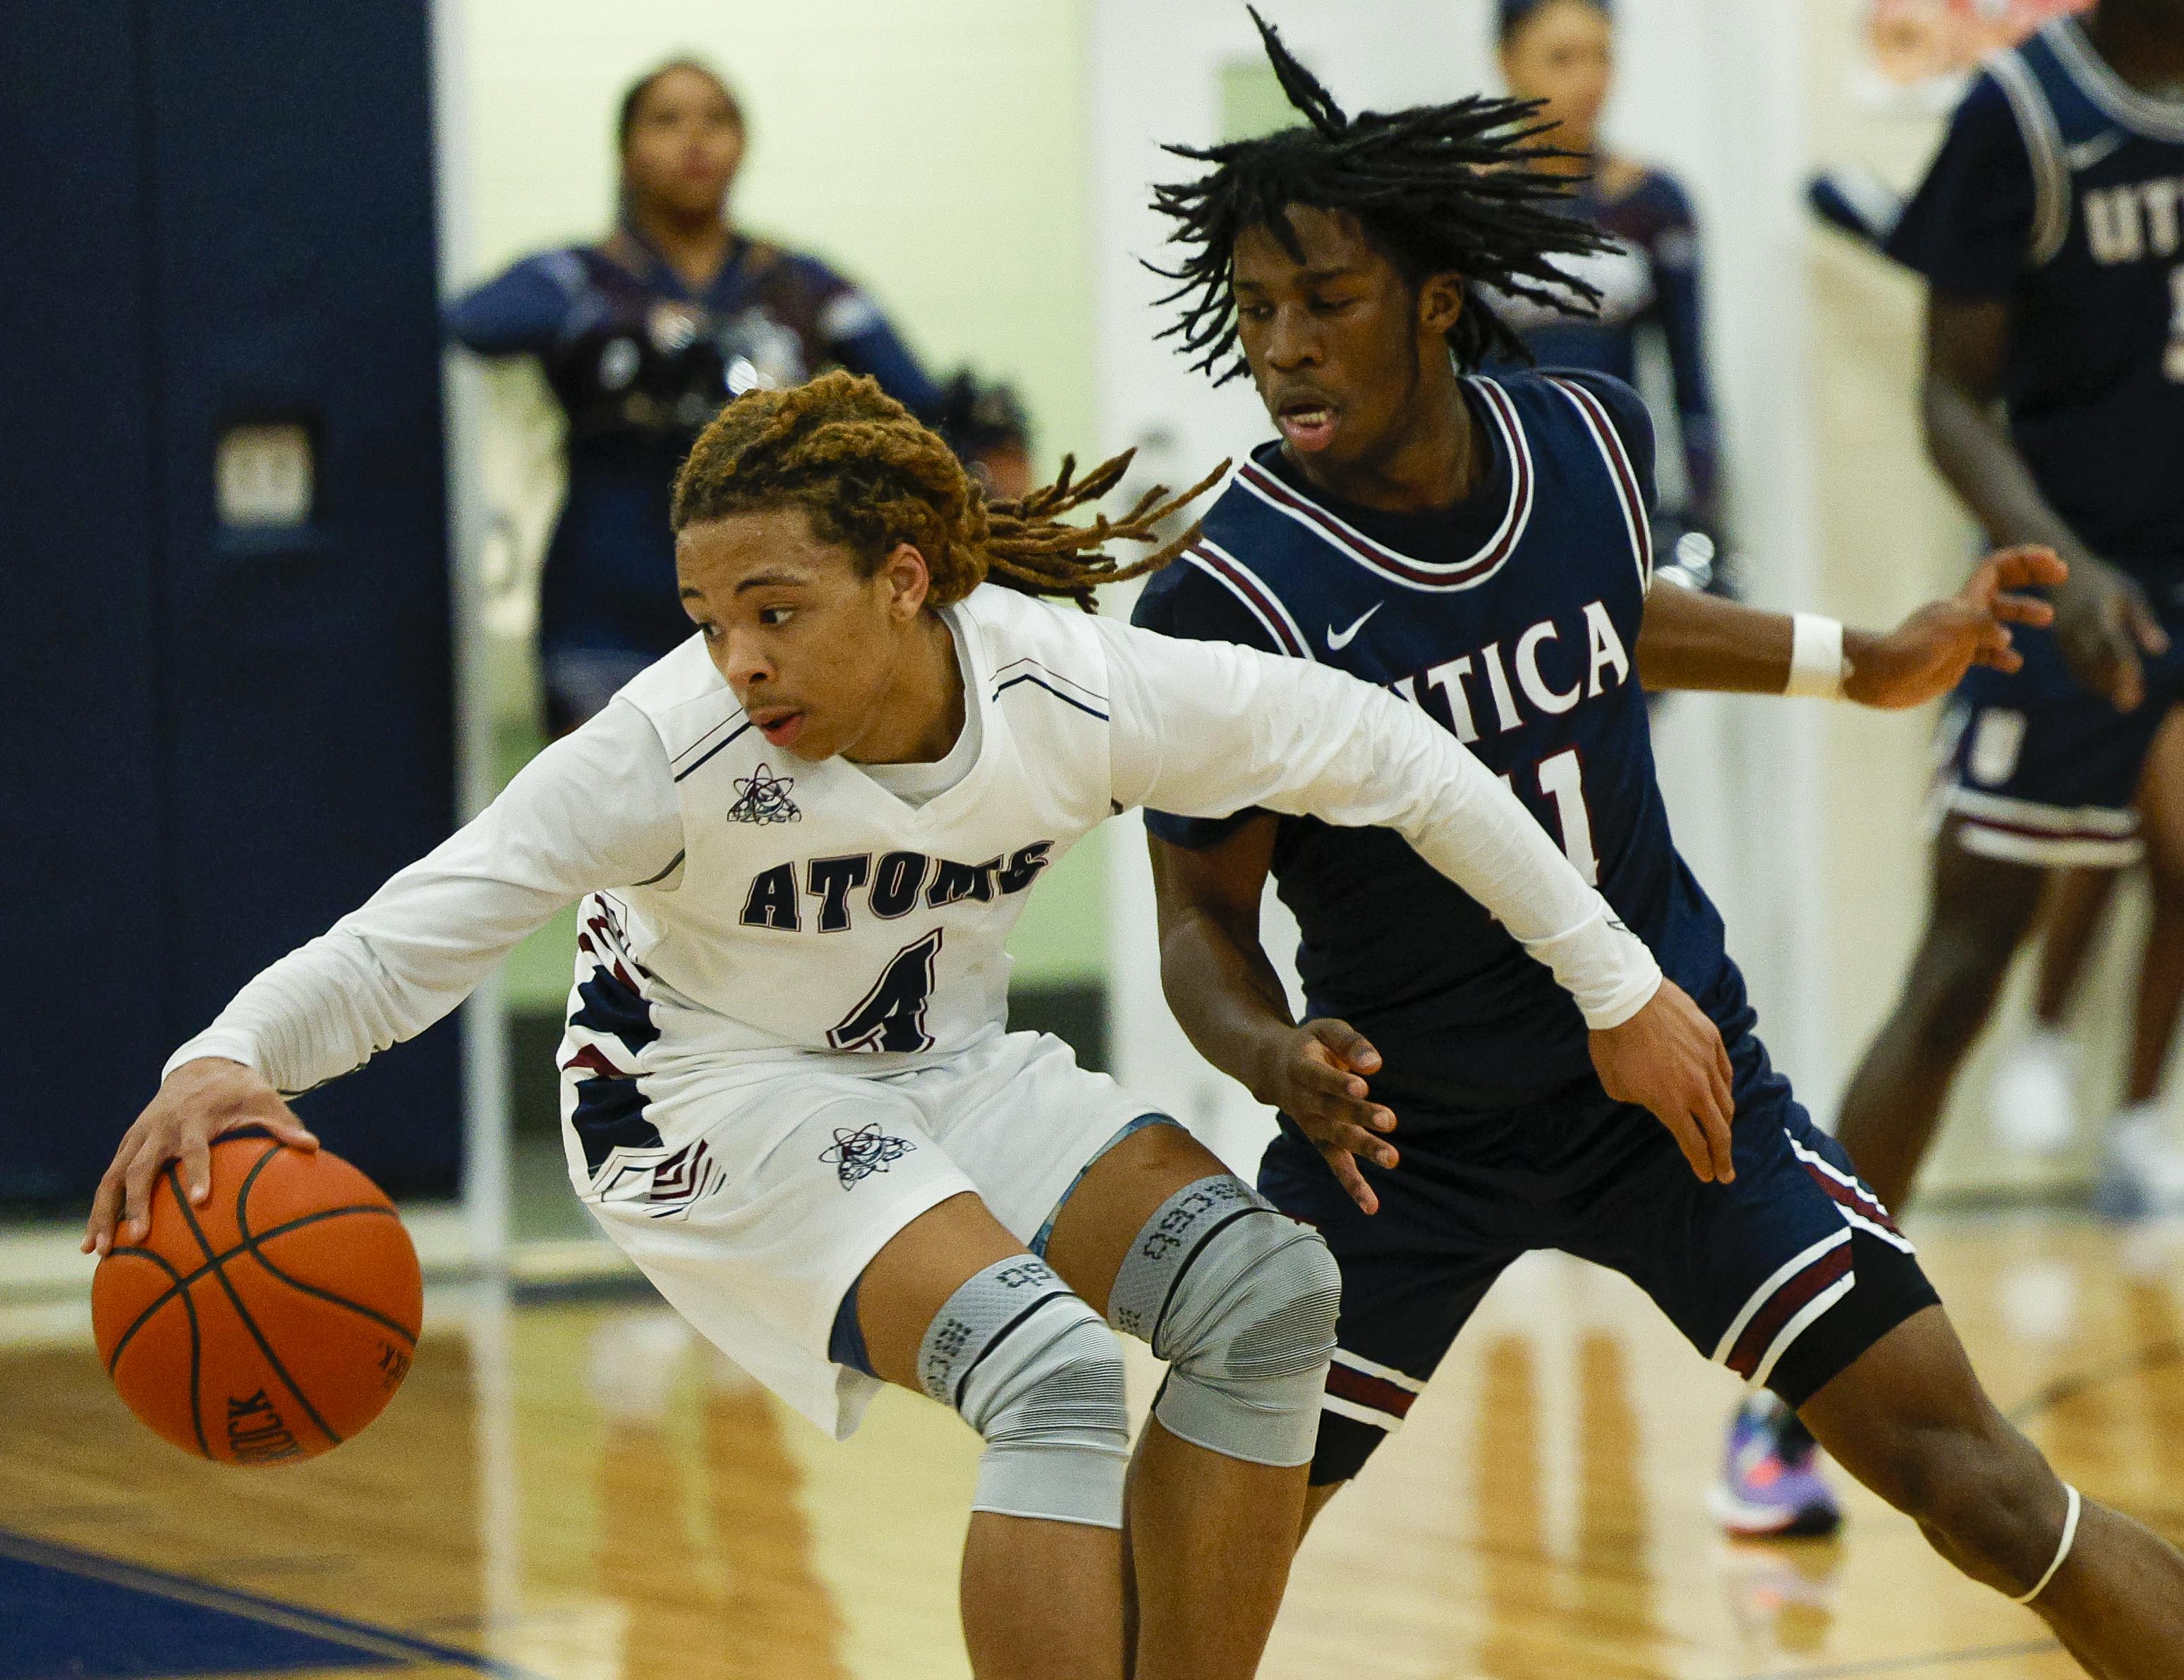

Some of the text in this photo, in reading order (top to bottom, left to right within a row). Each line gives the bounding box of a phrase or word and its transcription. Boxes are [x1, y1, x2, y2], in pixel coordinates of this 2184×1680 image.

[1391, 599, 1630, 744] TICA
[1497, 748, 1600, 887] 1
[739, 840, 1055, 934] ATOMS
[825, 926, 943, 1053] 4
